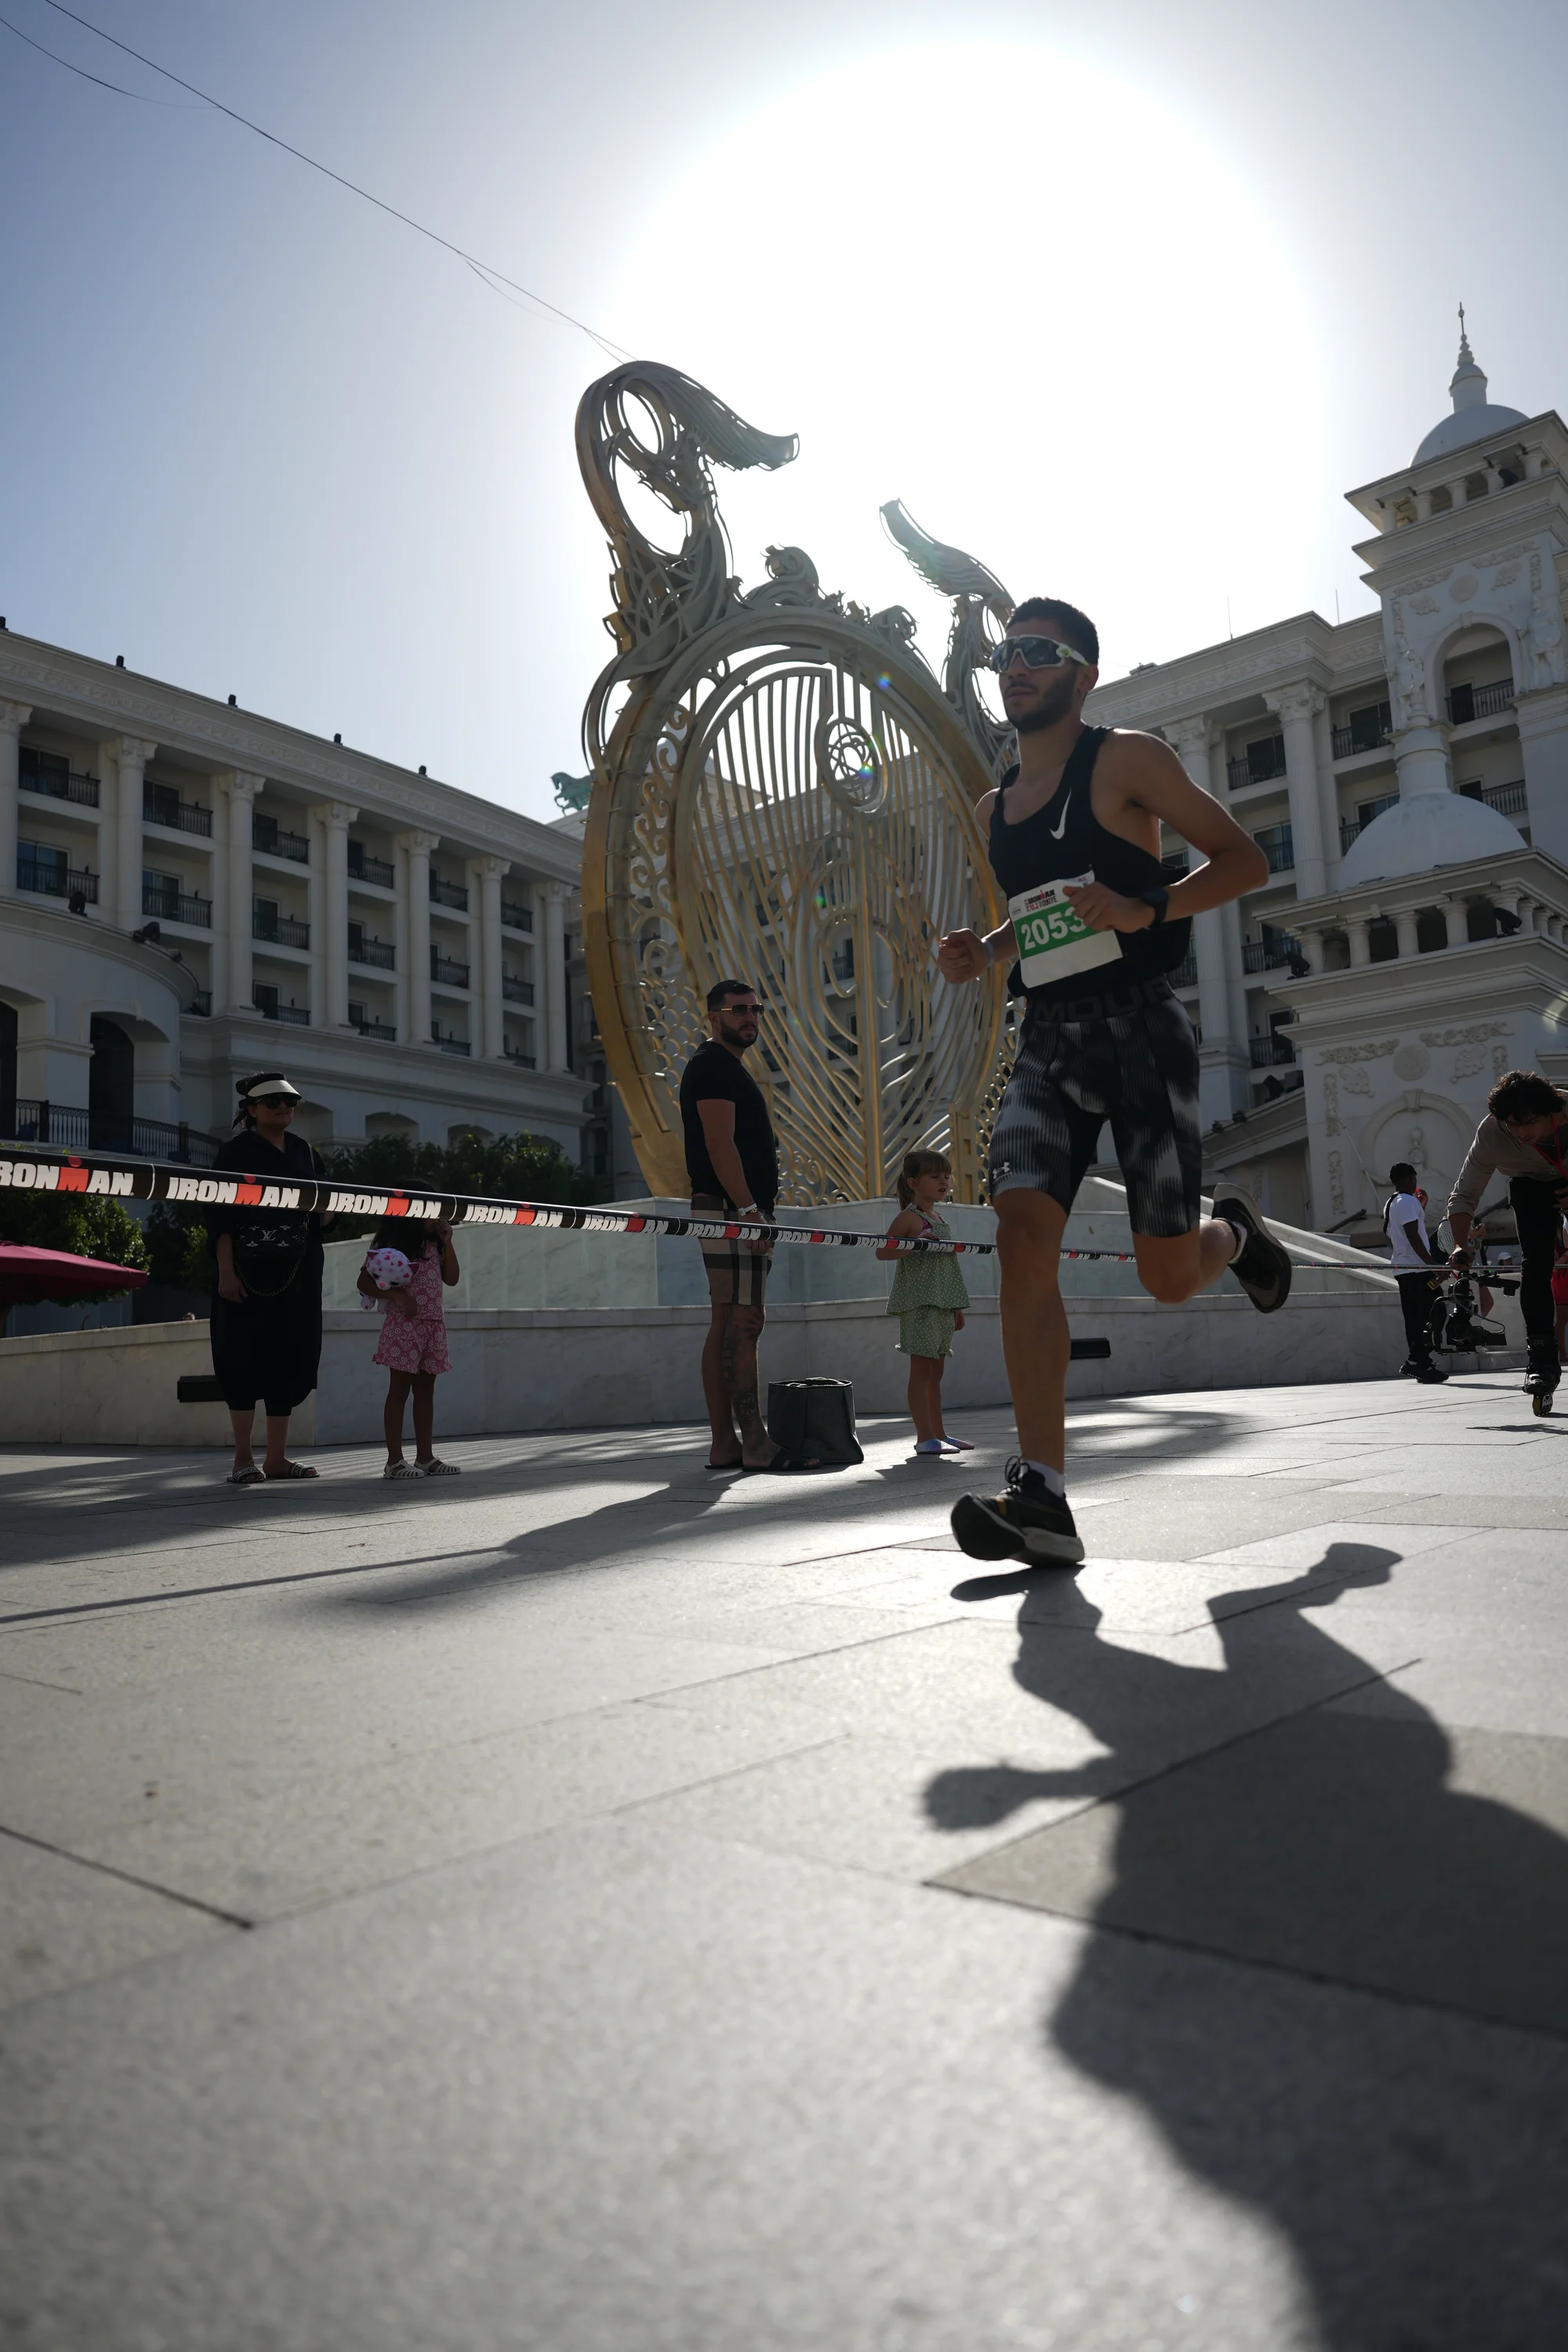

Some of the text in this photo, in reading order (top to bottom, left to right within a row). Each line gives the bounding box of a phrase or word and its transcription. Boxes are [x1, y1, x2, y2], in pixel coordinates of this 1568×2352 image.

[1026, 976, 1172, 1022] MOUR
[0, 1156, 134, 1196] RONMAN
[166, 1174, 300, 1208] IRONMAN
[326, 1189, 442, 1219] IRONMAN
[464, 1203, 563, 1228] IRONMAN
[582, 1213, 670, 1235] IRONMAN
[684, 1222, 761, 1240] IRONMAN
[775, 1230, 843, 1245] IRONMAN
